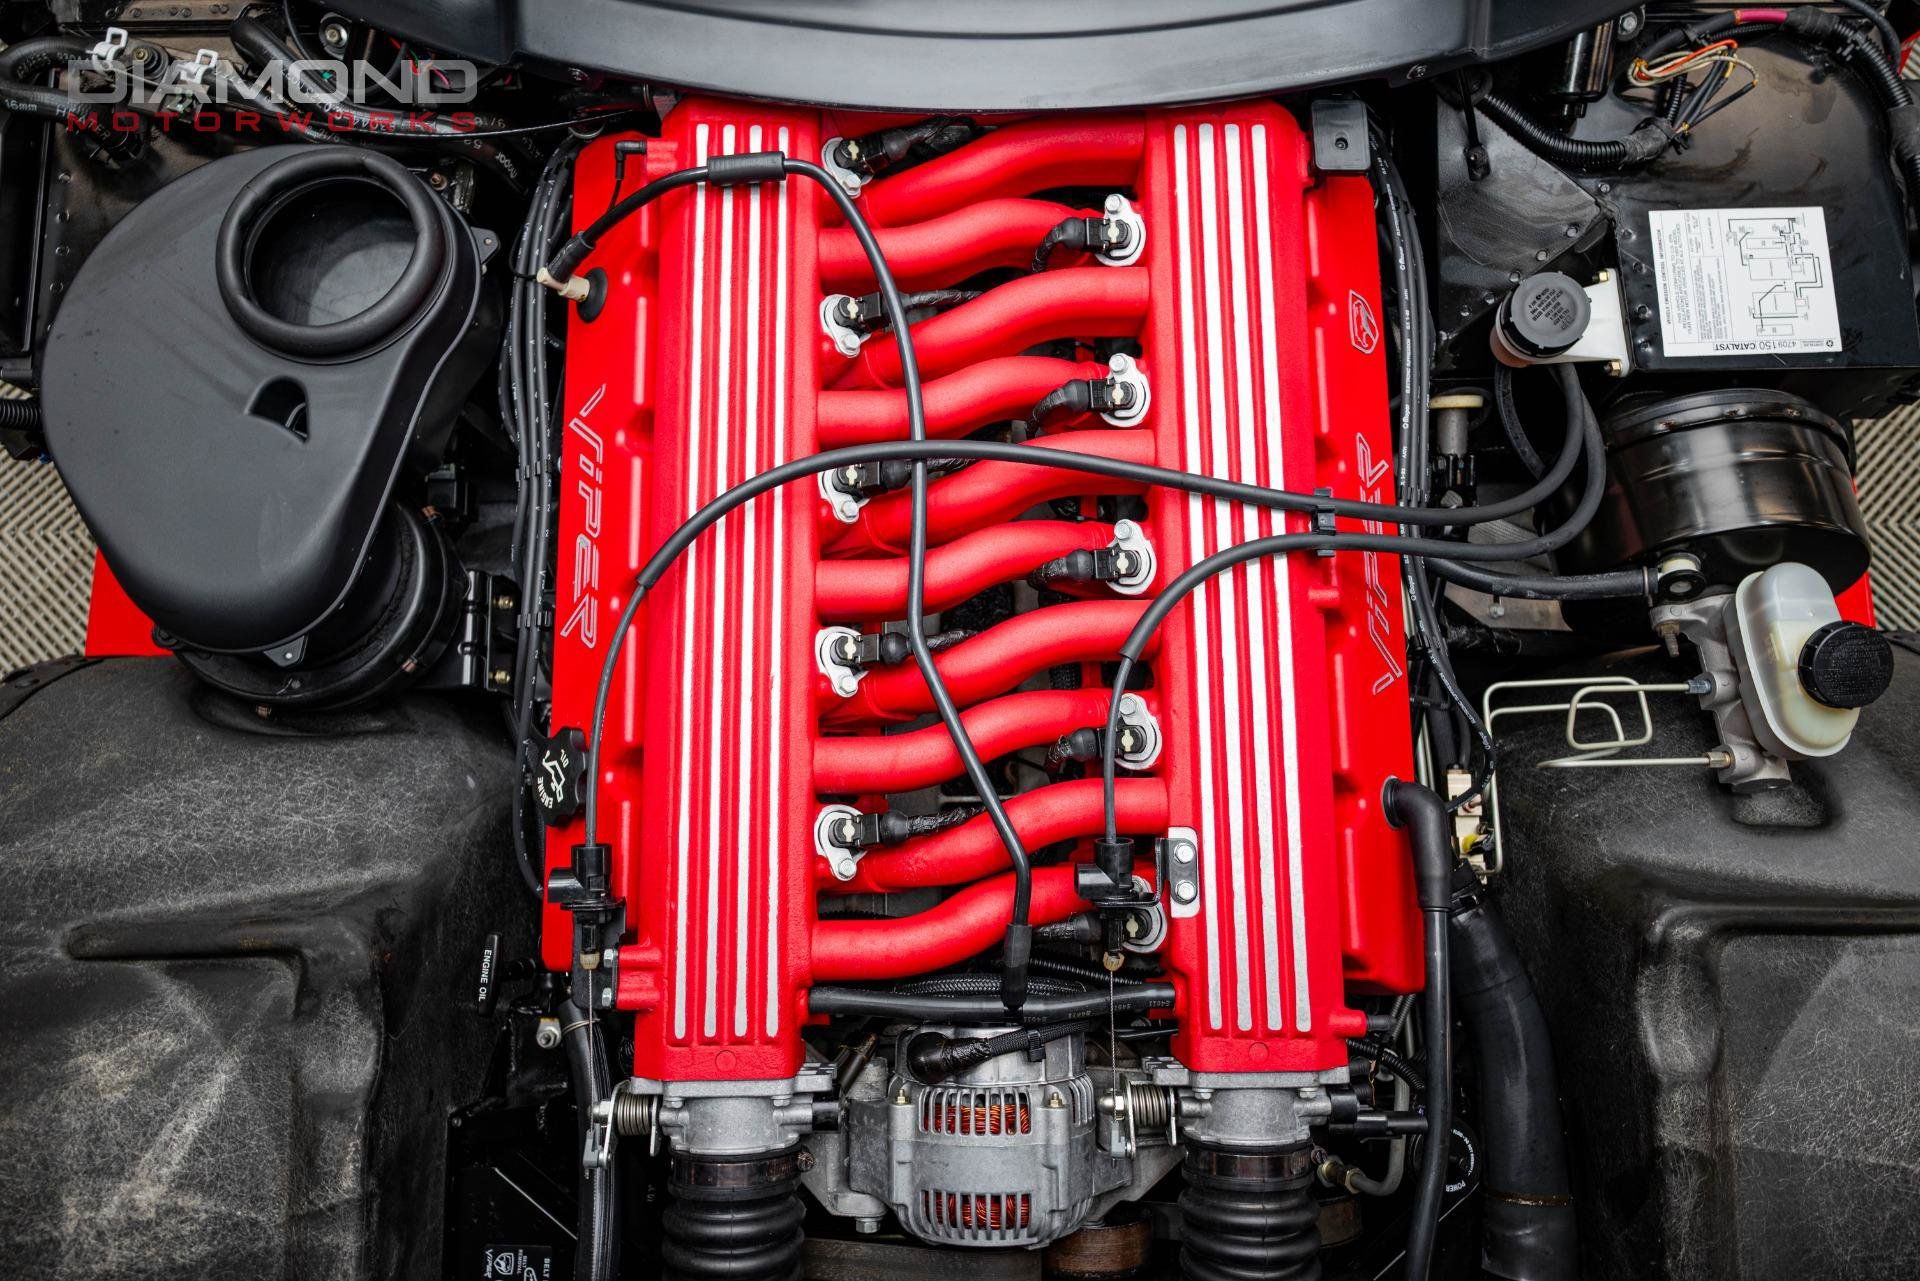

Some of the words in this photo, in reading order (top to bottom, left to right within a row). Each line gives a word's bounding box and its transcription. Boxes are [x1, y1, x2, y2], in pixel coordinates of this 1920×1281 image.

[1714, 342, 1756, 351] CATALYST
[1759, 342, 1776, 350] 150
[559, 382, 606, 649] VIPER
[537, 776, 554, 809] ENGINE
[561, 749, 570, 769] OIL
[480, 949, 493, 984] ENGINE
[478, 986, 487, 1002] OIL
[1445, 1179, 1466, 1192] POWER
[483, 1248, 494, 1279] VIPER
[543, 1257, 551, 1278] BELT
